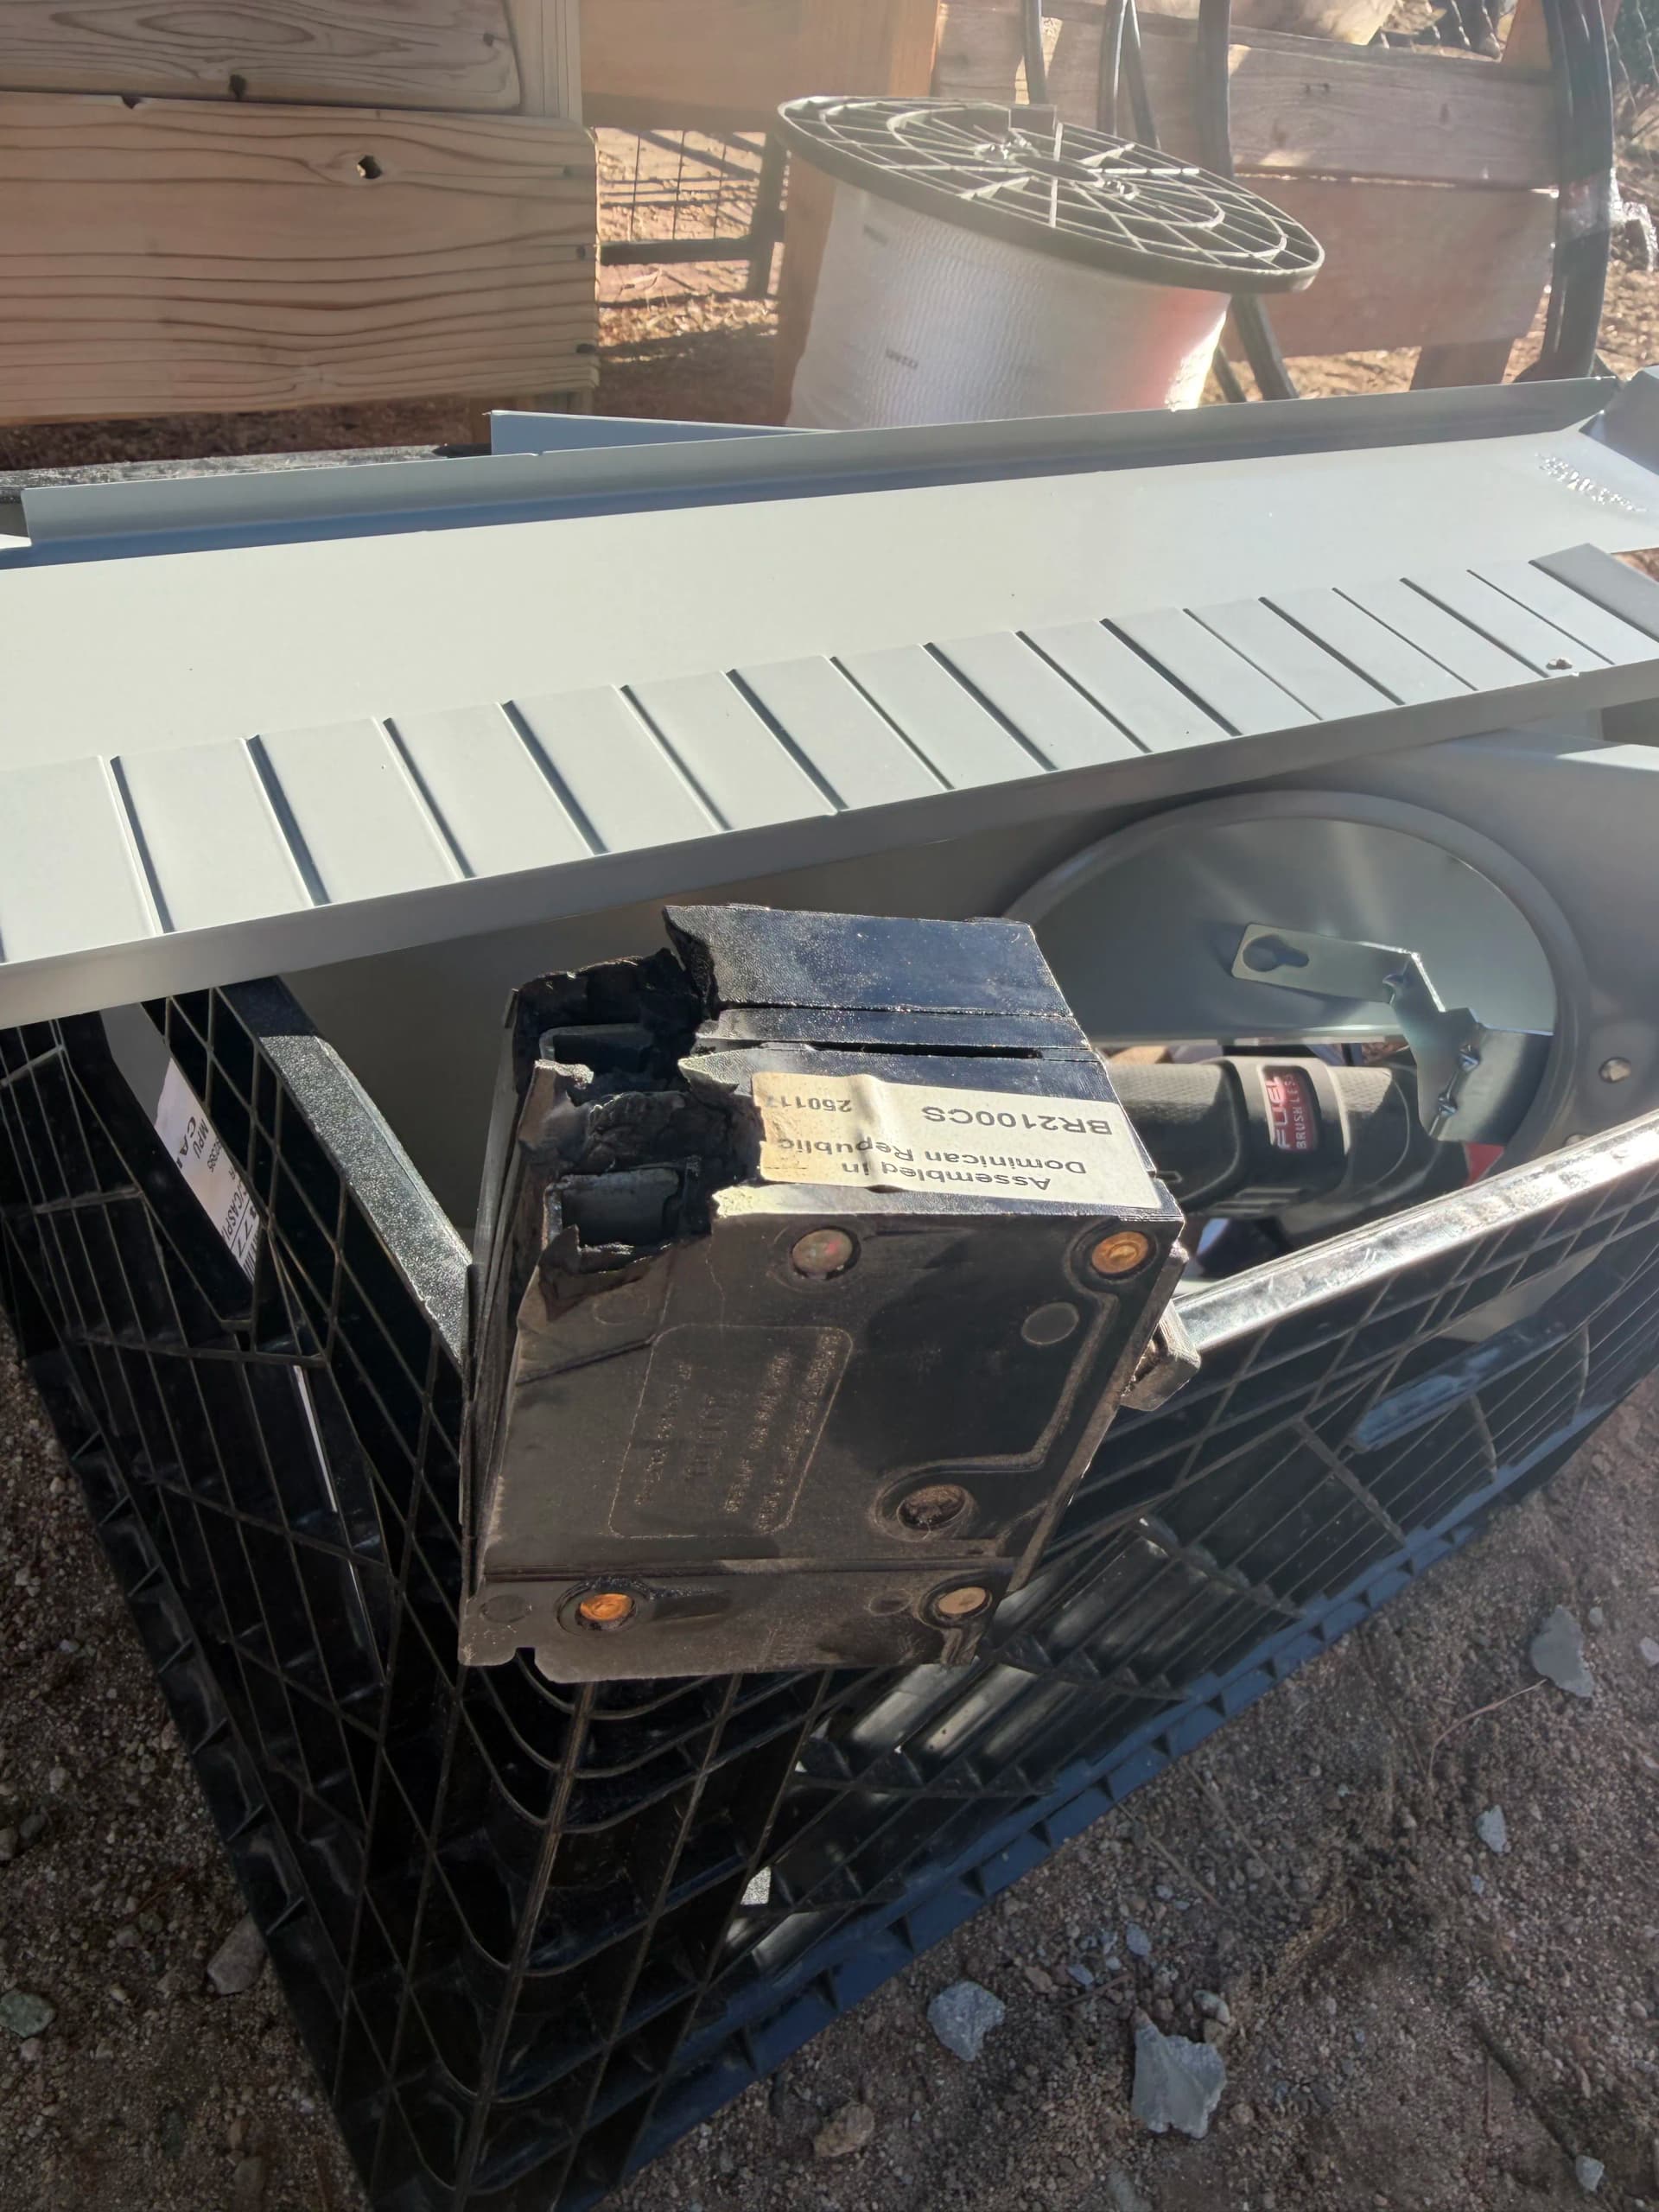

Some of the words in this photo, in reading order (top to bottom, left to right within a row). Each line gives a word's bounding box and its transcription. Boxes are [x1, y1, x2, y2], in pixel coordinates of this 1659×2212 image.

[921, 1105, 1113, 1135] BR2100CS
[1265, 1077, 1291, 1149] FUEL
[193, 1117, 209, 1160] MPU
[778, 1136, 914, 1161] Republic
[842, 1162, 869, 1176] in
[881, 1161, 1052, 1191] Assembled
[925, 1149, 1087, 1174] Dominican
